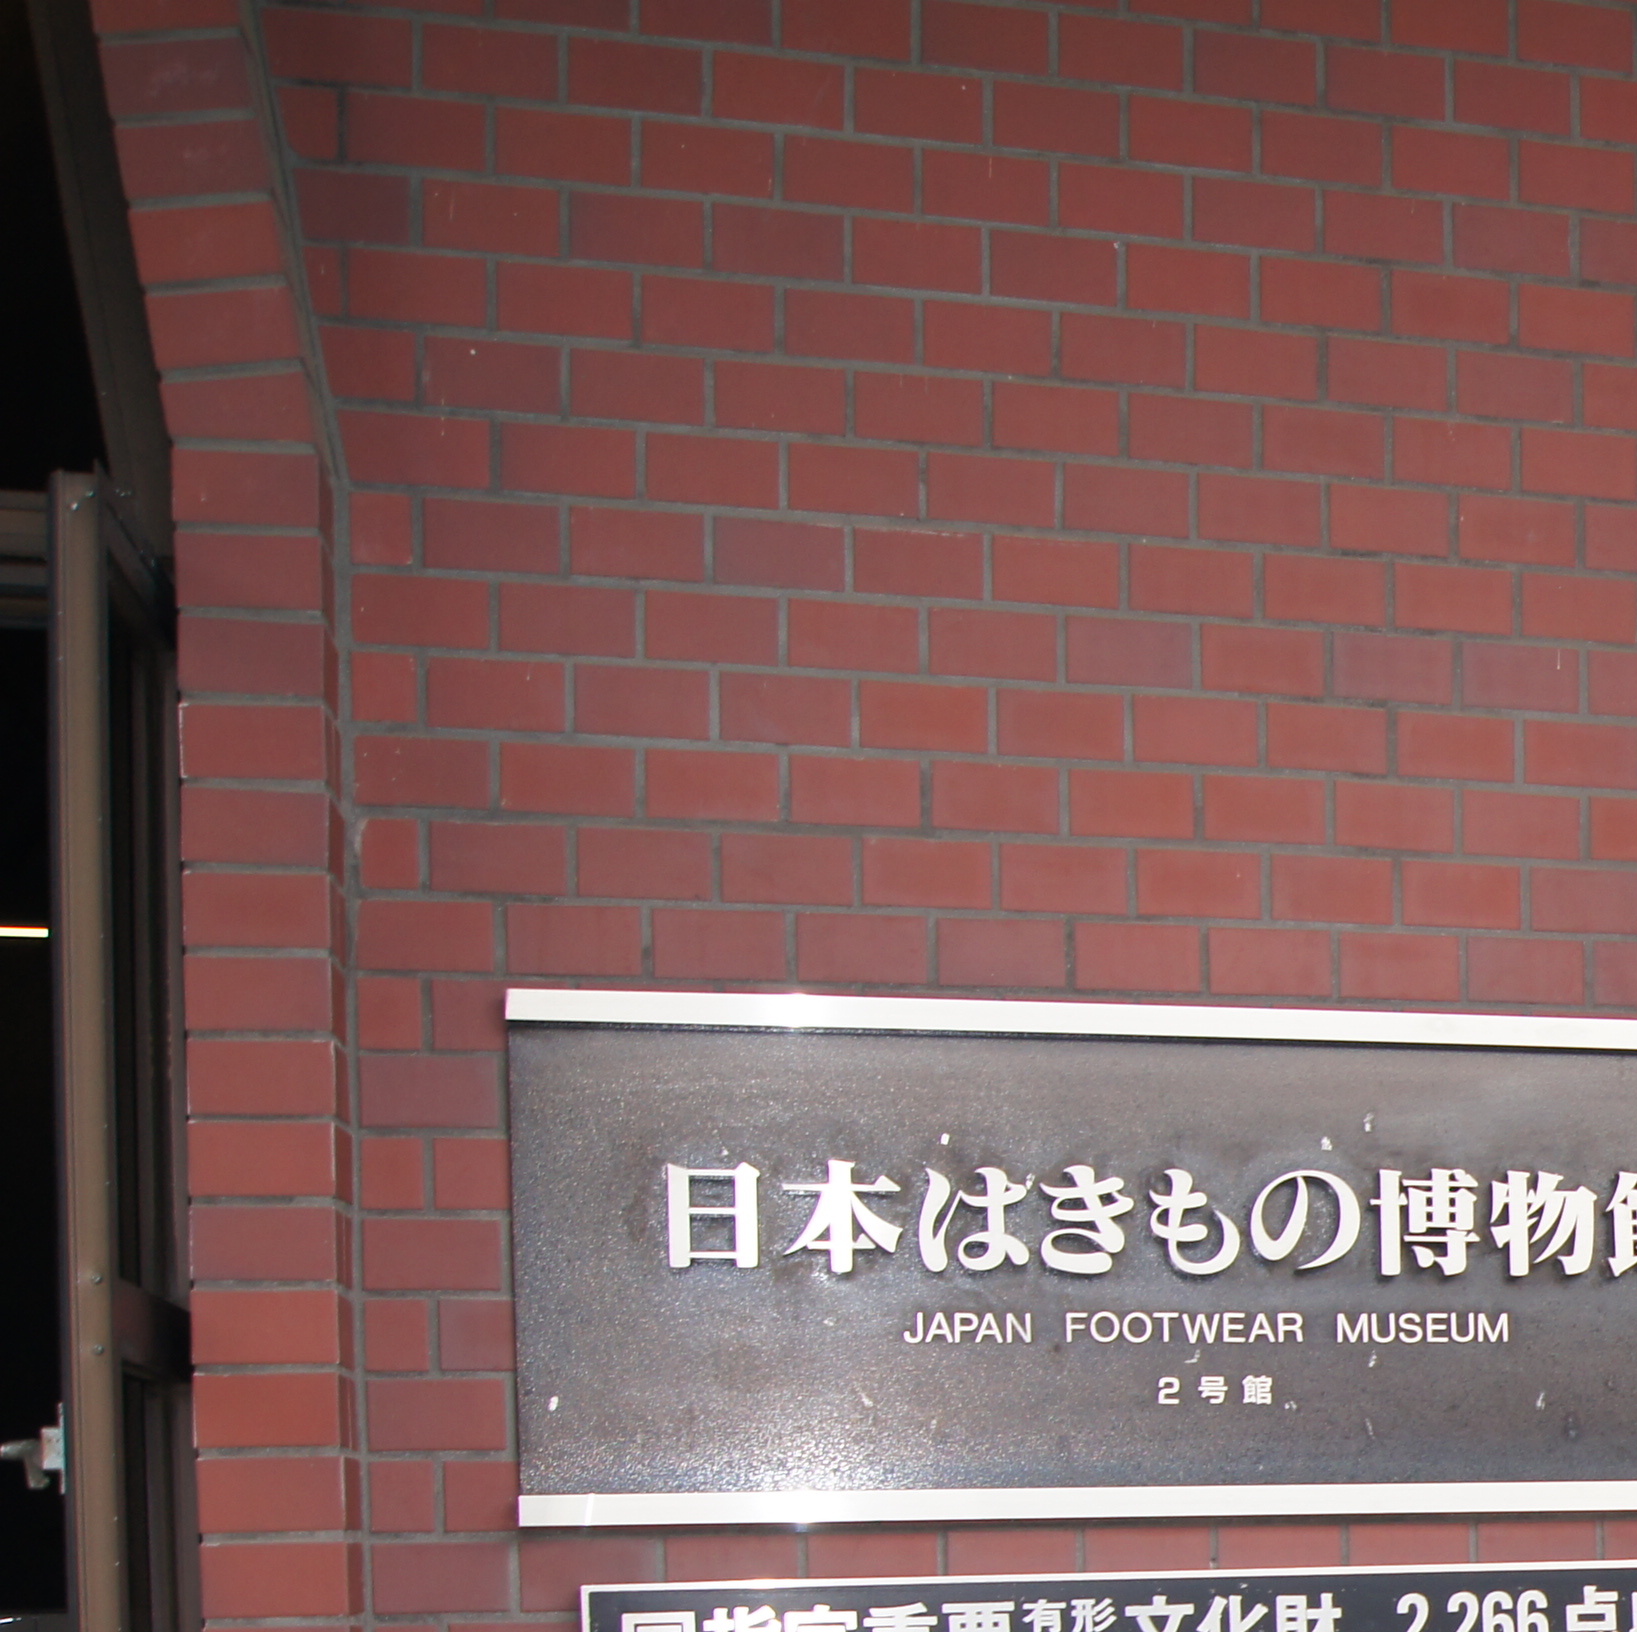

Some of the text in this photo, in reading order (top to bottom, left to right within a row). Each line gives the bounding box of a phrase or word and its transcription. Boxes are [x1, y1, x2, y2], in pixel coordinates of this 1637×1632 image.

[903, 1311, 1510, 1345] JAPAN FOOTWEAR MUSEUM
[1158, 1374, 1274, 1406] 2号館
